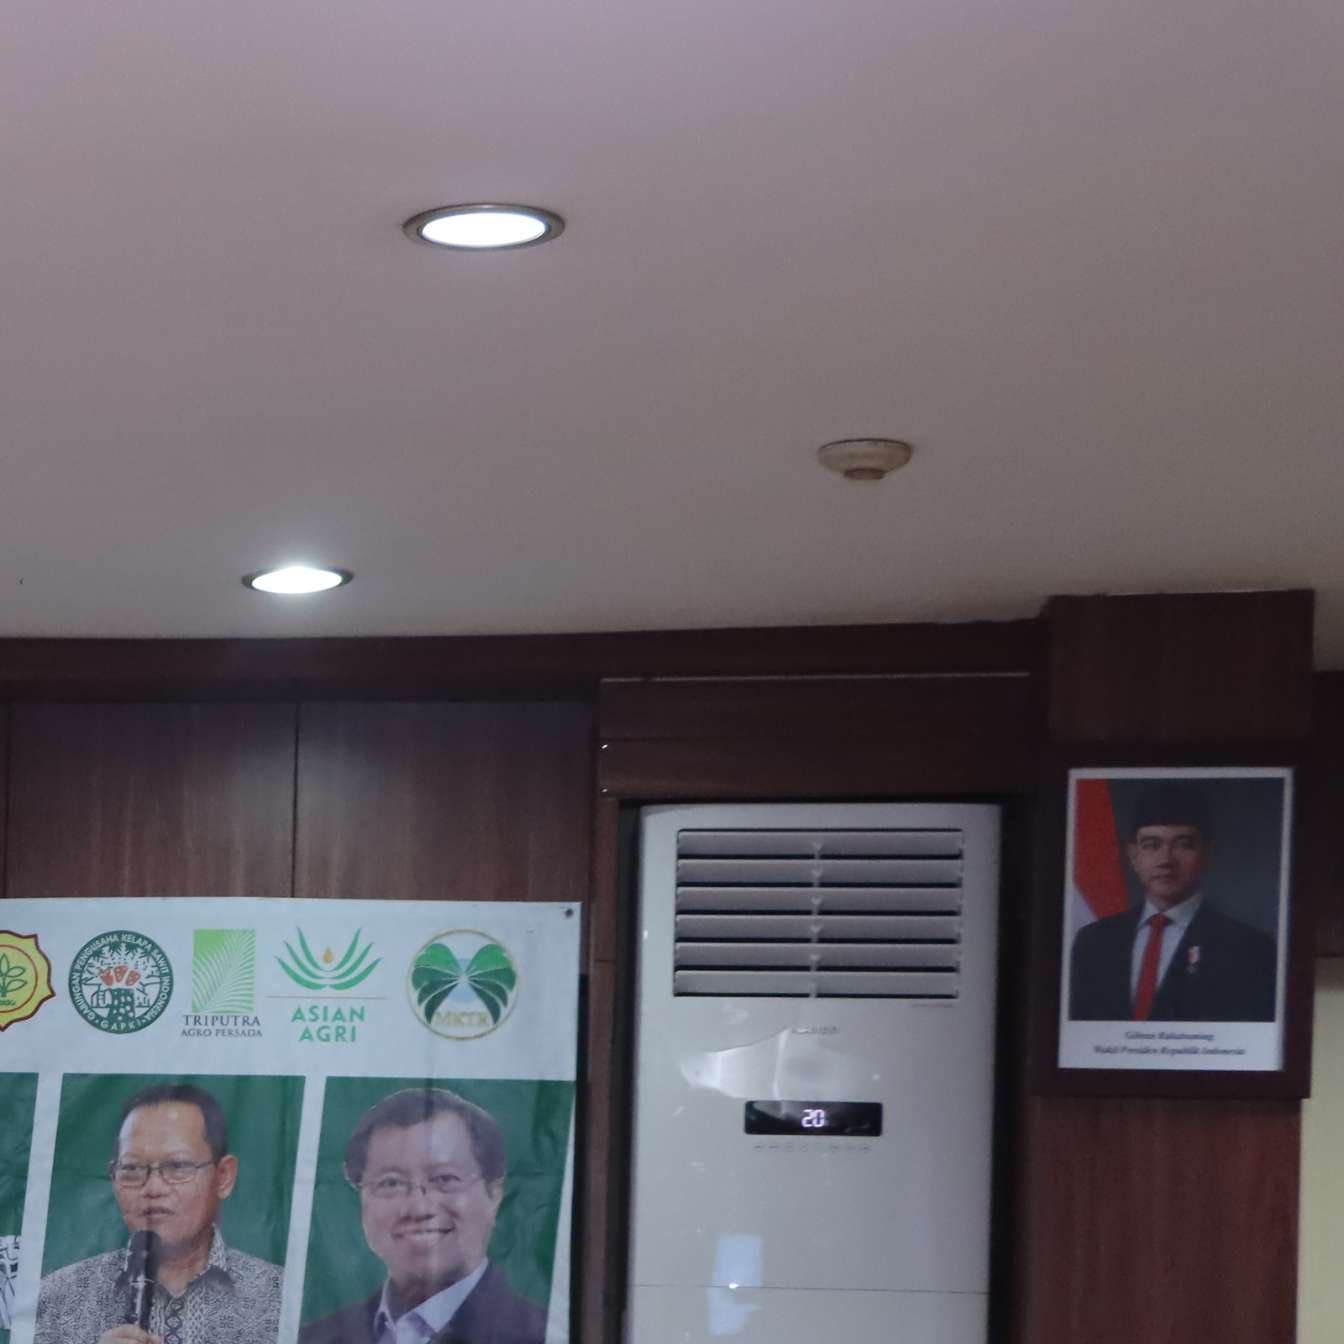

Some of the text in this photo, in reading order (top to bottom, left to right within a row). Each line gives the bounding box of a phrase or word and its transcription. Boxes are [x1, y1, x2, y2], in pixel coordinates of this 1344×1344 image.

[183, 1014, 261, 1027] TRIPUTRA
[291, 1005, 365, 1023] ASIAN
[181, 1028, 263, 1038] AGRO PERSADA
[298, 1025, 356, 1042] AGRI
[801, 1108, 825, 1127] 20
